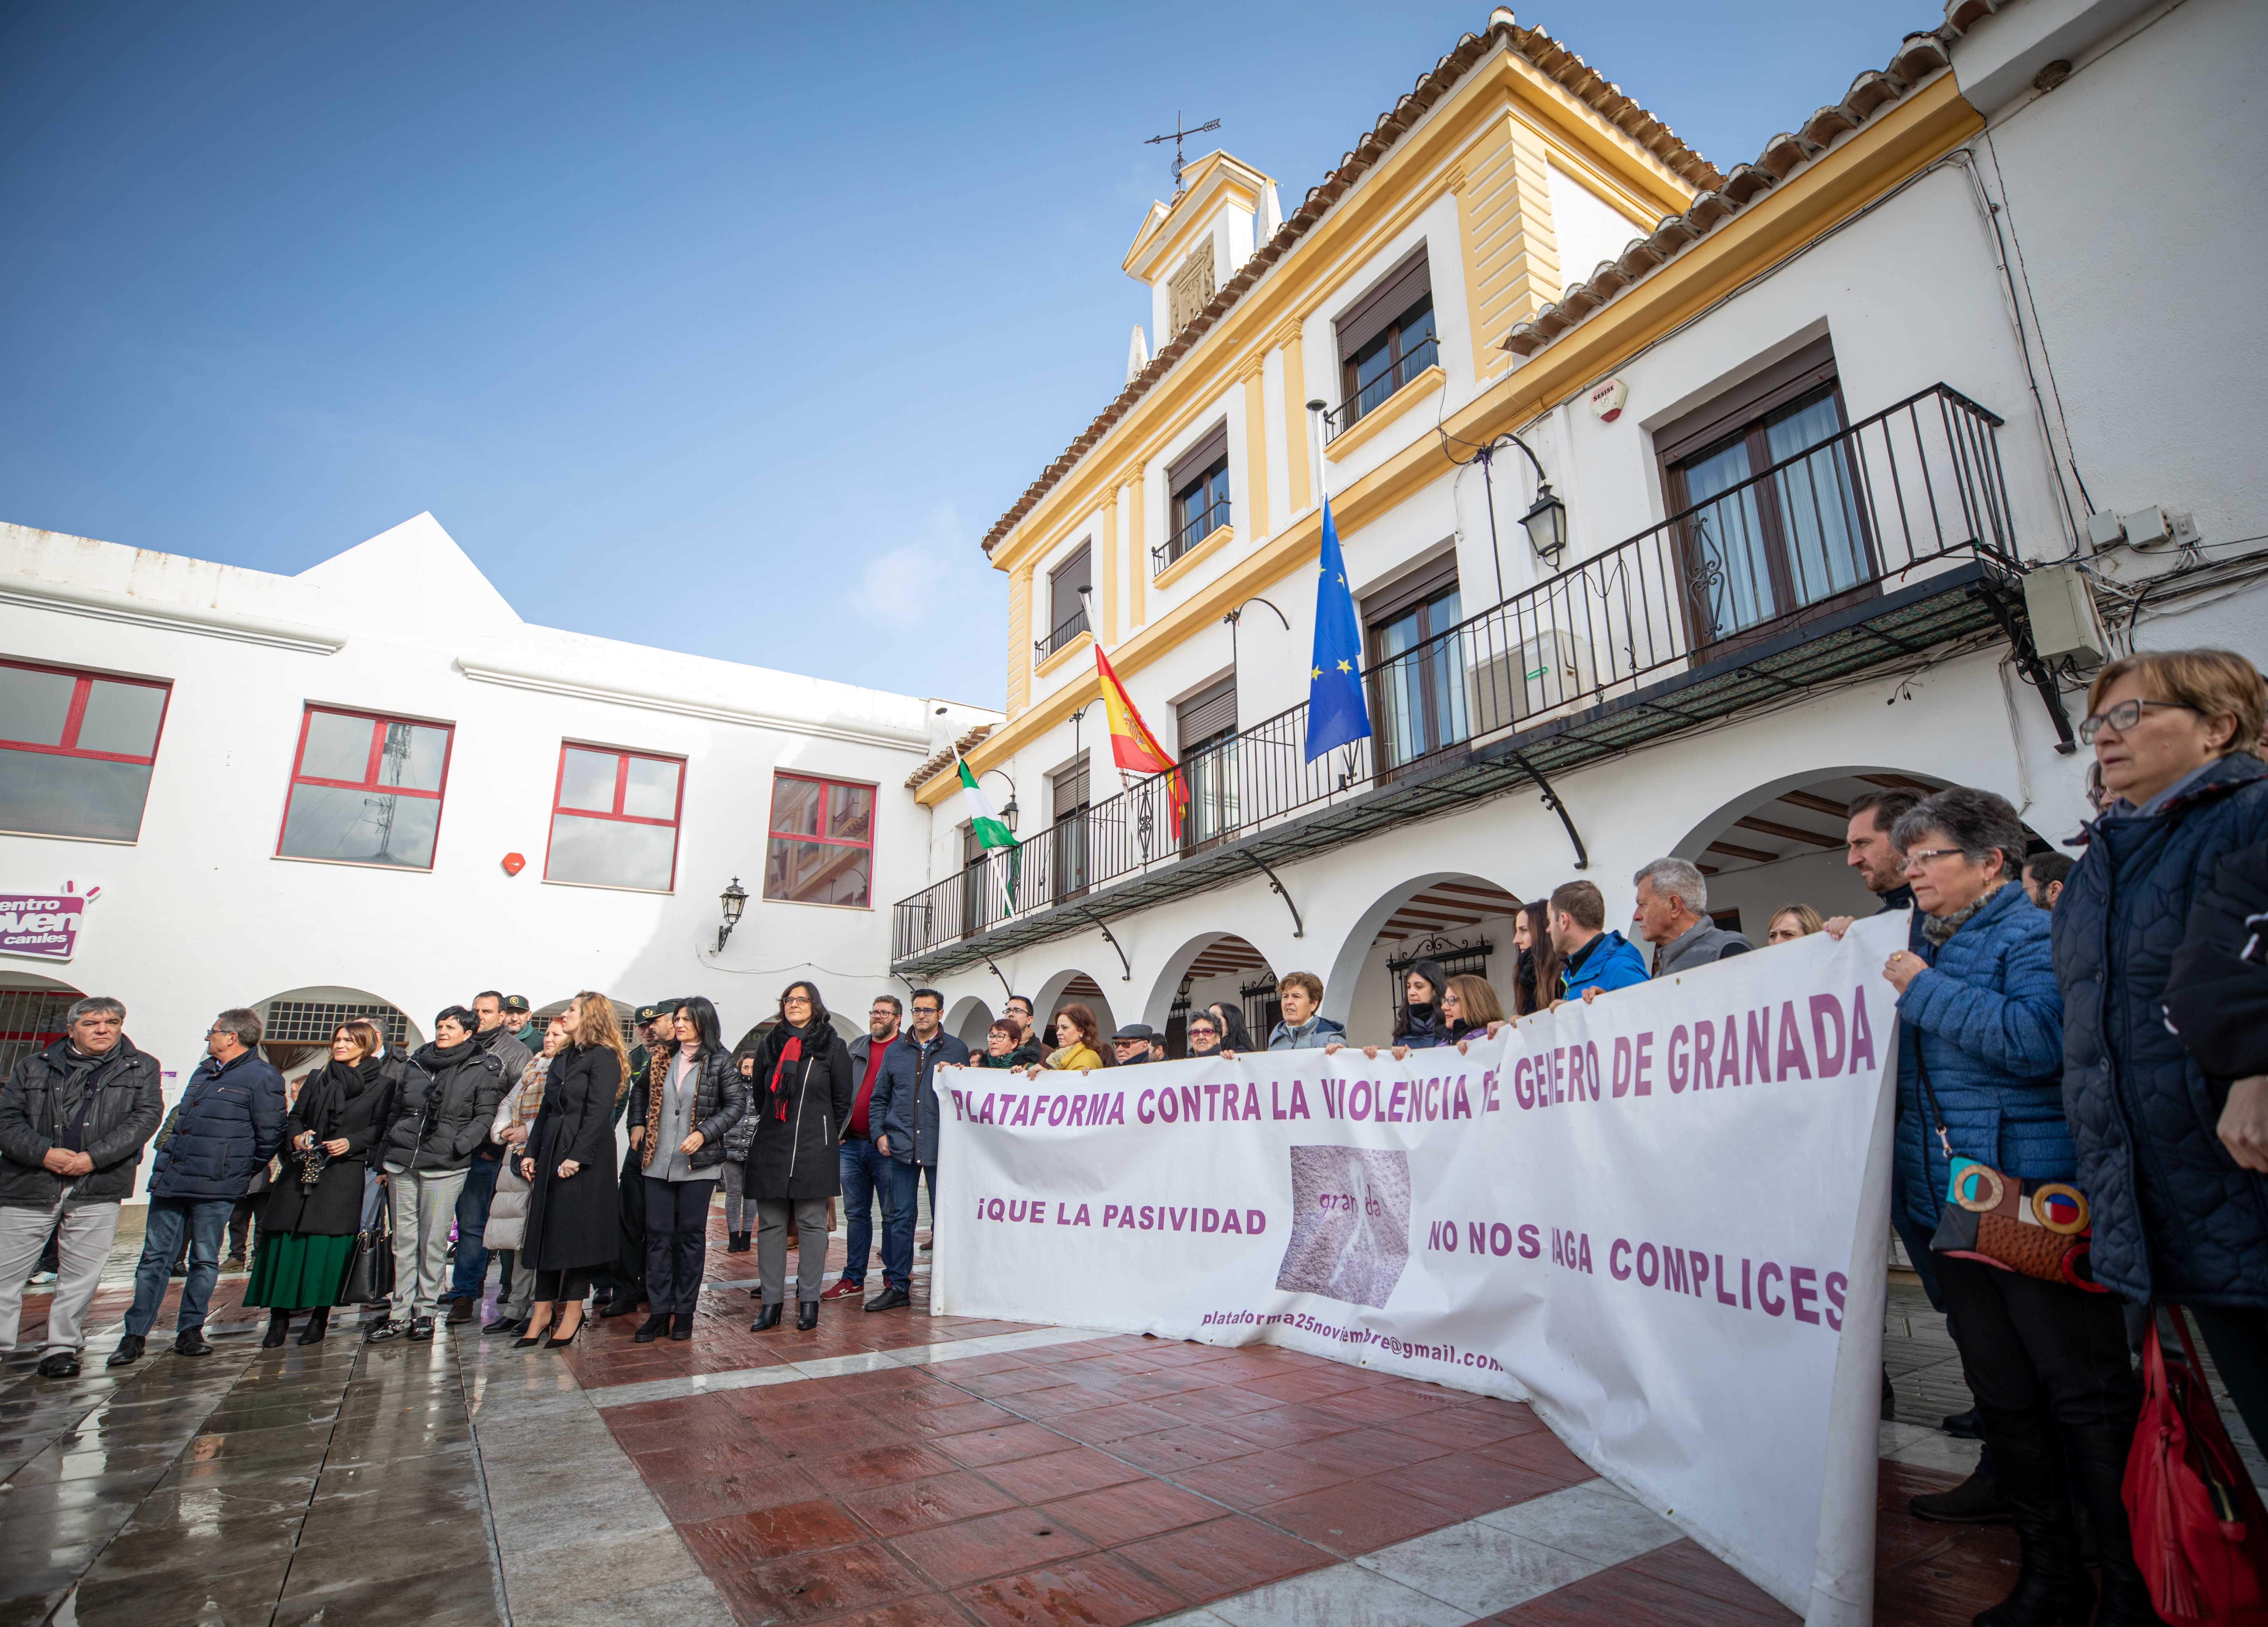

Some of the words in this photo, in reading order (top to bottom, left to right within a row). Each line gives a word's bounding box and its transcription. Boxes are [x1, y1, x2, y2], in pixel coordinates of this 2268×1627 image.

[1593, 385, 1614, 401] SESISE
[951, 1090, 1125, 1127] PLATAFORMA
[1137, 1083, 1261, 1124] CONTRA
[1272, 1080, 1310, 1120] LA
[1321, 1074, 1472, 1122] VIOLENCIA
[1612, 1032, 1653, 1098] DE
[1668, 985, 1876, 1094] GRANADA
[1057, 1202, 1091, 1226] LA
[1103, 1204, 1267, 1235] PASIVIDAD
[1428, 1221, 1458, 1252] NO
[1469, 1222, 1540, 1259] NOS
[1610, 1238, 1848, 1332] COMPLICES
